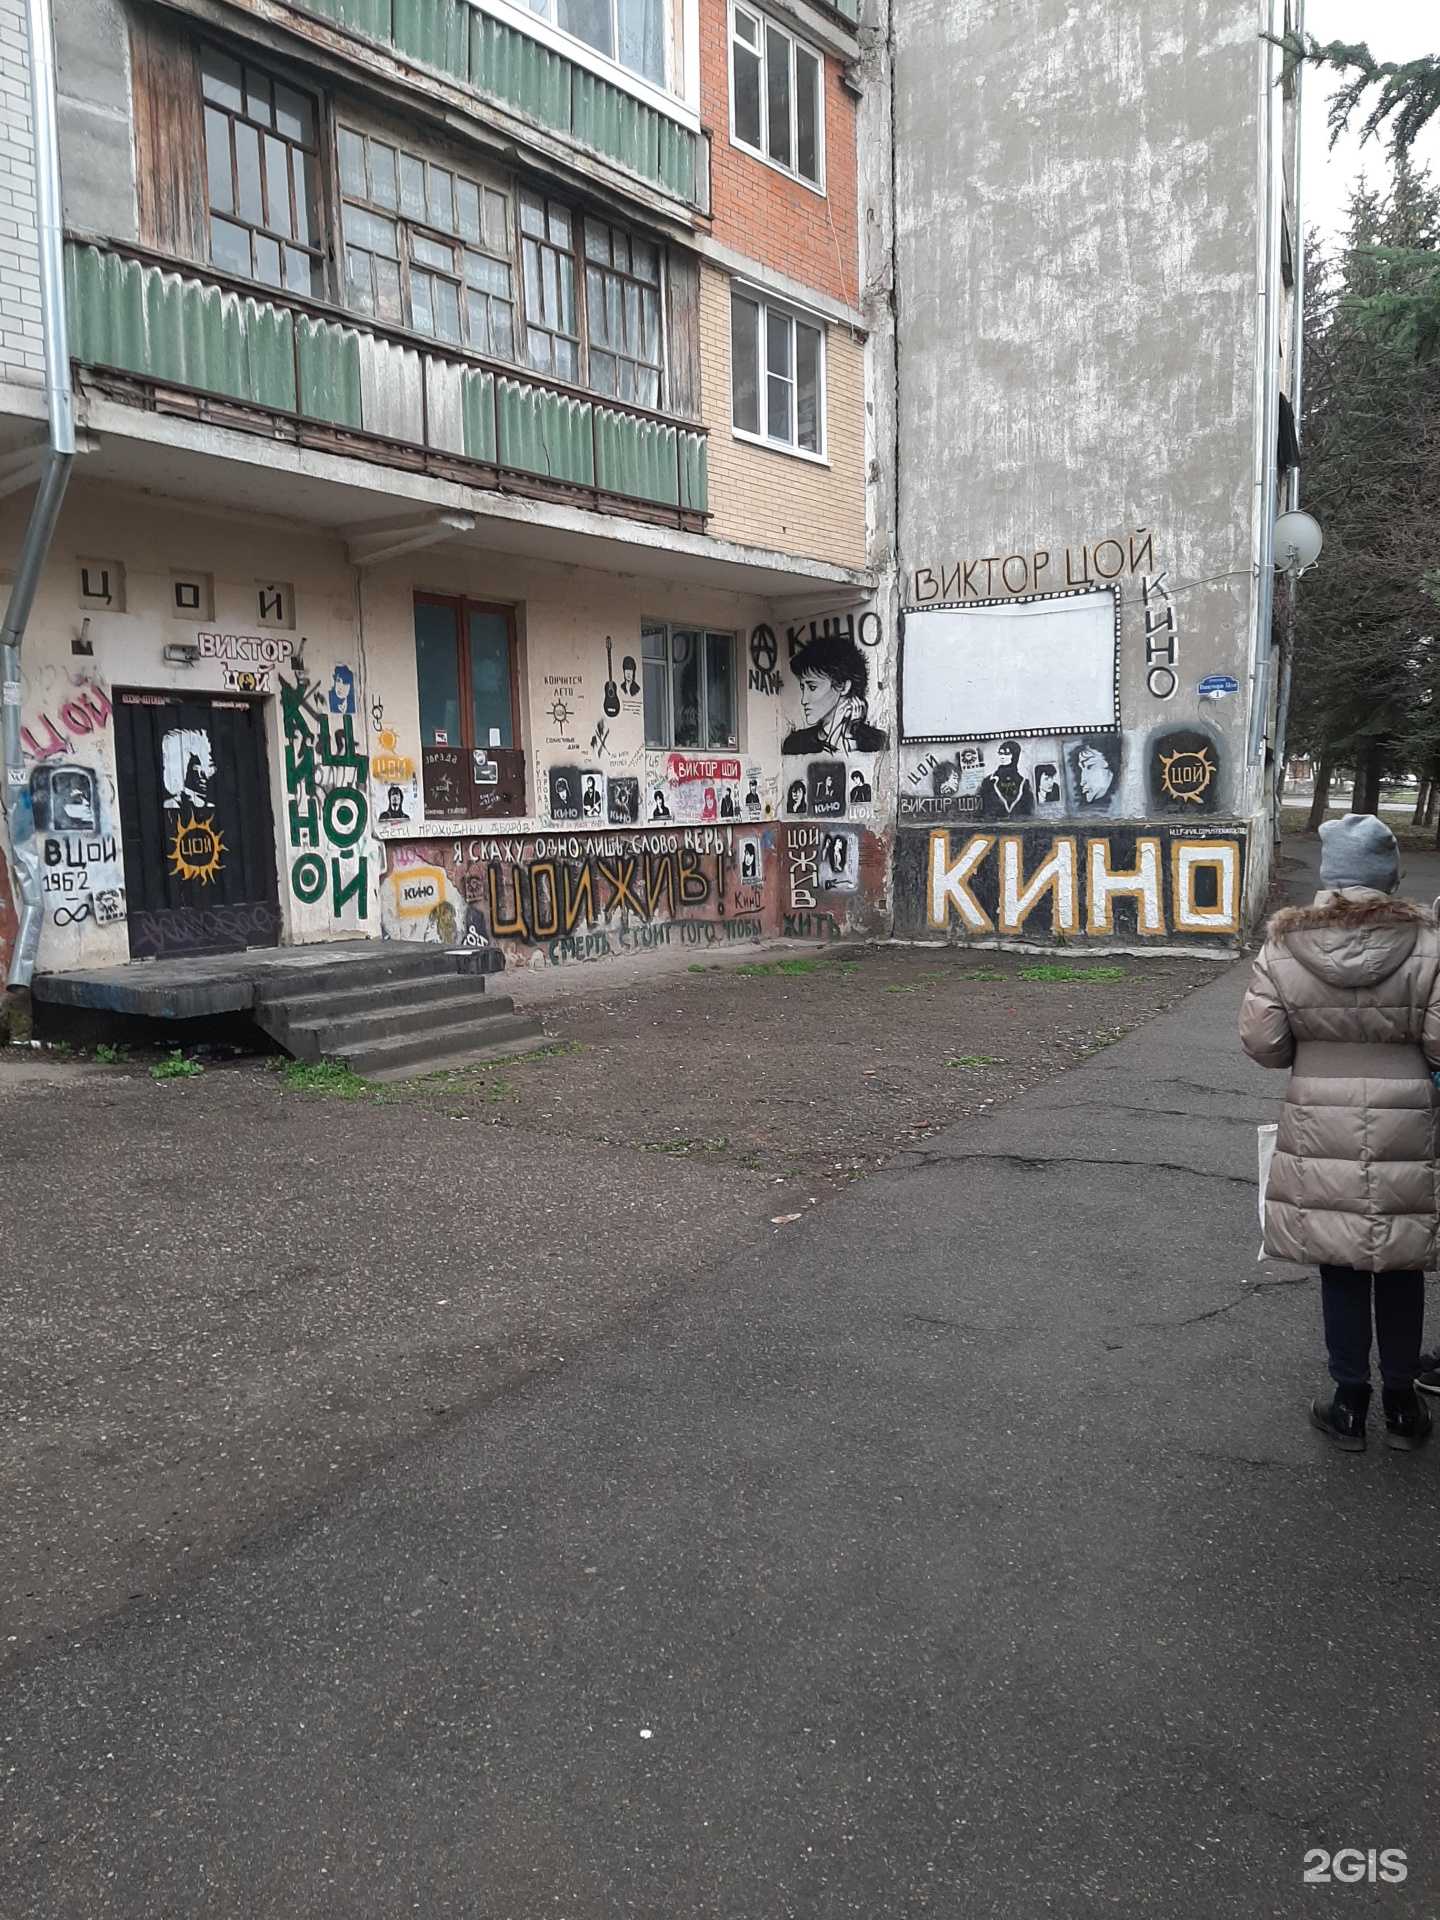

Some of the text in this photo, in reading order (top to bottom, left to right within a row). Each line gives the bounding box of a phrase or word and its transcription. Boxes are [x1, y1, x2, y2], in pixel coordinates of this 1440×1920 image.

[915, 528, 1153, 602] ВИКТОР ЦОЙ
[198, 632, 293, 662] ВИКТОР
[1142, 572, 1180, 701] КИНО
[678, 761, 717, 778] ВИКТОР
[907, 753, 939, 785] ЦОЙ
[1171, 762, 1204, 784] ЦОЙ
[319, 713, 369, 919] ЦОЙ
[553, 808, 578, 819] КИНО
[815, 801, 841, 814] КИНО
[901, 796, 984, 813] ВИКТОР ЦОЙ
[454, 841, 464, 863] Я
[469, 839, 524, 865] СКАЖУ
[586, 835, 623, 858] ЛИШЬ
[632, 833, 678, 856] СЛОВО
[787, 826, 820, 849] ЦОЙ
[42, 871, 90, 892] 1962
[403, 885, 434, 901] КИНО
[789, 850, 817, 909] ЖИВ
[928, 829, 1240, 936] КИНО
[550, 930, 610, 966] СМЕРТЬ
[619, 922, 673, 948] СТОИТ
[721, 918, 761, 941] ЧТОБЫ
